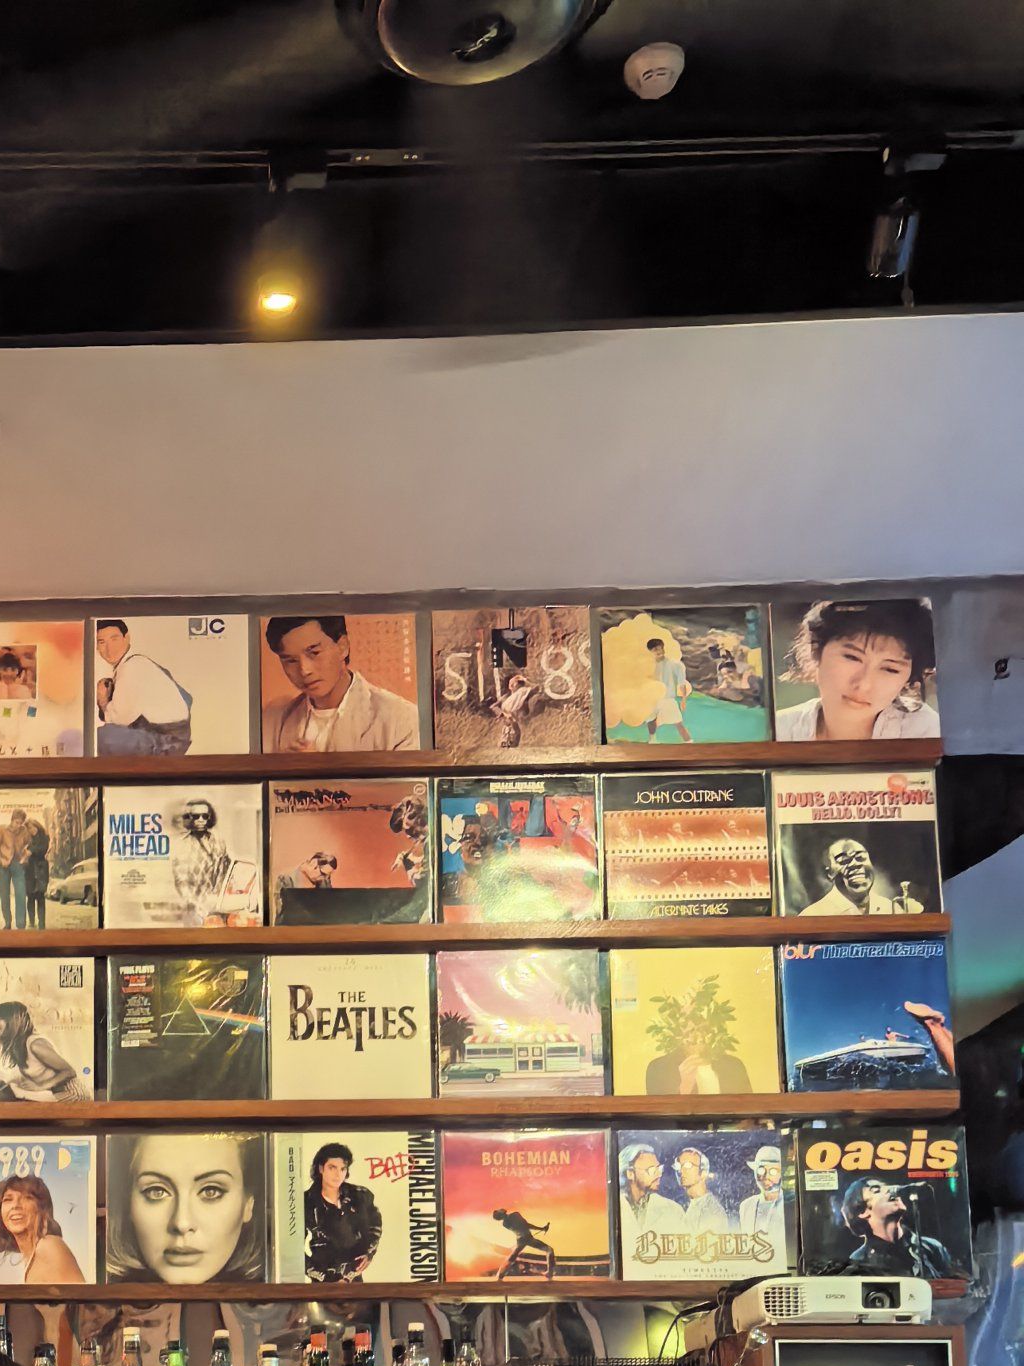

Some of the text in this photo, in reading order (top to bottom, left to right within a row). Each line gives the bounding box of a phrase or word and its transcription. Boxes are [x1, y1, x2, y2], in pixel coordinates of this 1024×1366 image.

[634, 788, 734, 804] JOHN COLTRANE
[776, 791, 826, 808] LOUIS
[109, 813, 163, 835] MILES
[109, 834, 170, 857] AHEAD
[649, 902, 729, 918] ALTERNATE TAKES
[784, 943, 821, 960] blur
[337, 991, 367, 1003] THE
[287, 984, 418, 1052] BEATLES
[481, 1149, 571, 1166] BOHEMIAN
[805, 1129, 959, 1172] oasis
[364, 1151, 416, 1183] BAD
[407, 1131, 437, 1207] MICHAEL
[490, 1166, 563, 1178] RHAPSODY
